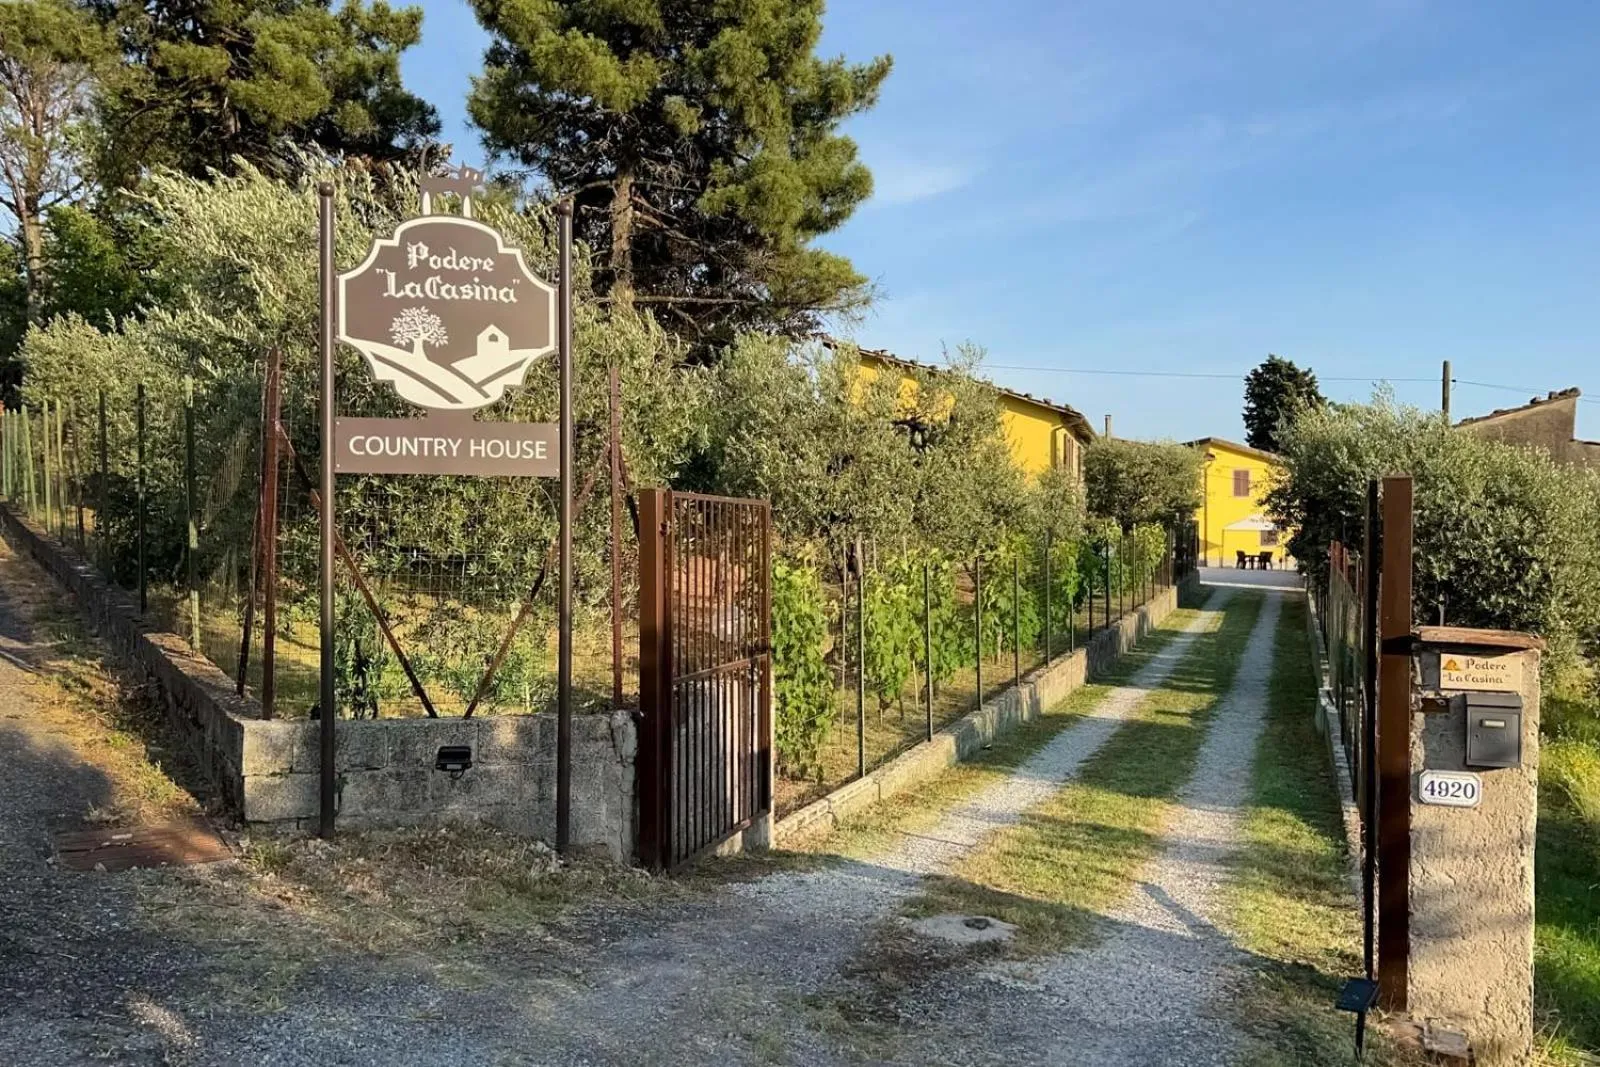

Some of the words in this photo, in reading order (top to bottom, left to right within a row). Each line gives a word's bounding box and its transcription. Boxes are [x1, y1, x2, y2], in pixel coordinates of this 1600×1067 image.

[407, 242, 494, 271] Podere
[349, 435, 462, 457] COUNTRY
[470, 438, 548, 460] HOUSE
[1466, 658, 1507, 671] Podere
[1424, 780, 1475, 799] 4920
